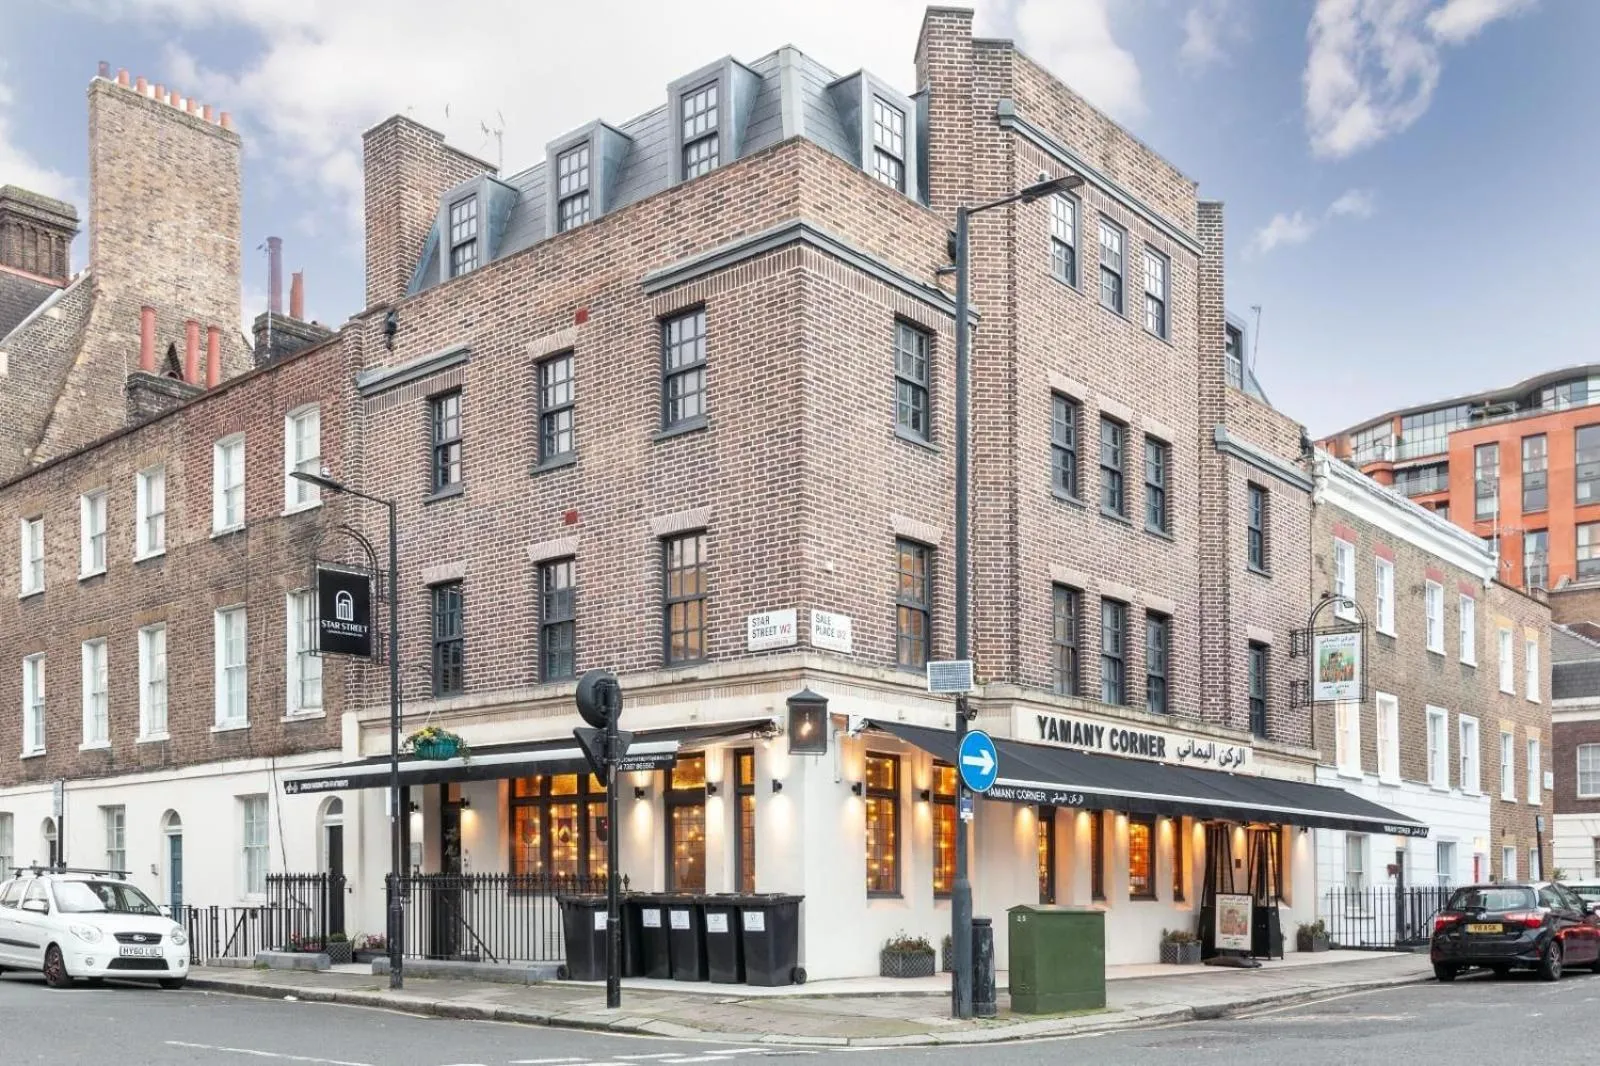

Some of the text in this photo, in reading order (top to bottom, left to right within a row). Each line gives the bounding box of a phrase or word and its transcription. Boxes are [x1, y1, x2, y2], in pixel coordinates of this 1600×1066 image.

[752, 615, 770, 627] STAR
[816, 613, 831, 625] SALE
[320, 619, 340, 629] STAR
[341, 623, 368, 633] STREET
[752, 624, 791, 639] STREET W2
[815, 625, 835, 638] PLACE
[1037, 714, 1166, 758] YAMANY CORNER
[1176, 739, 1246, 769] الركن اليماني
[1018, 789, 1047, 802] CORNER
